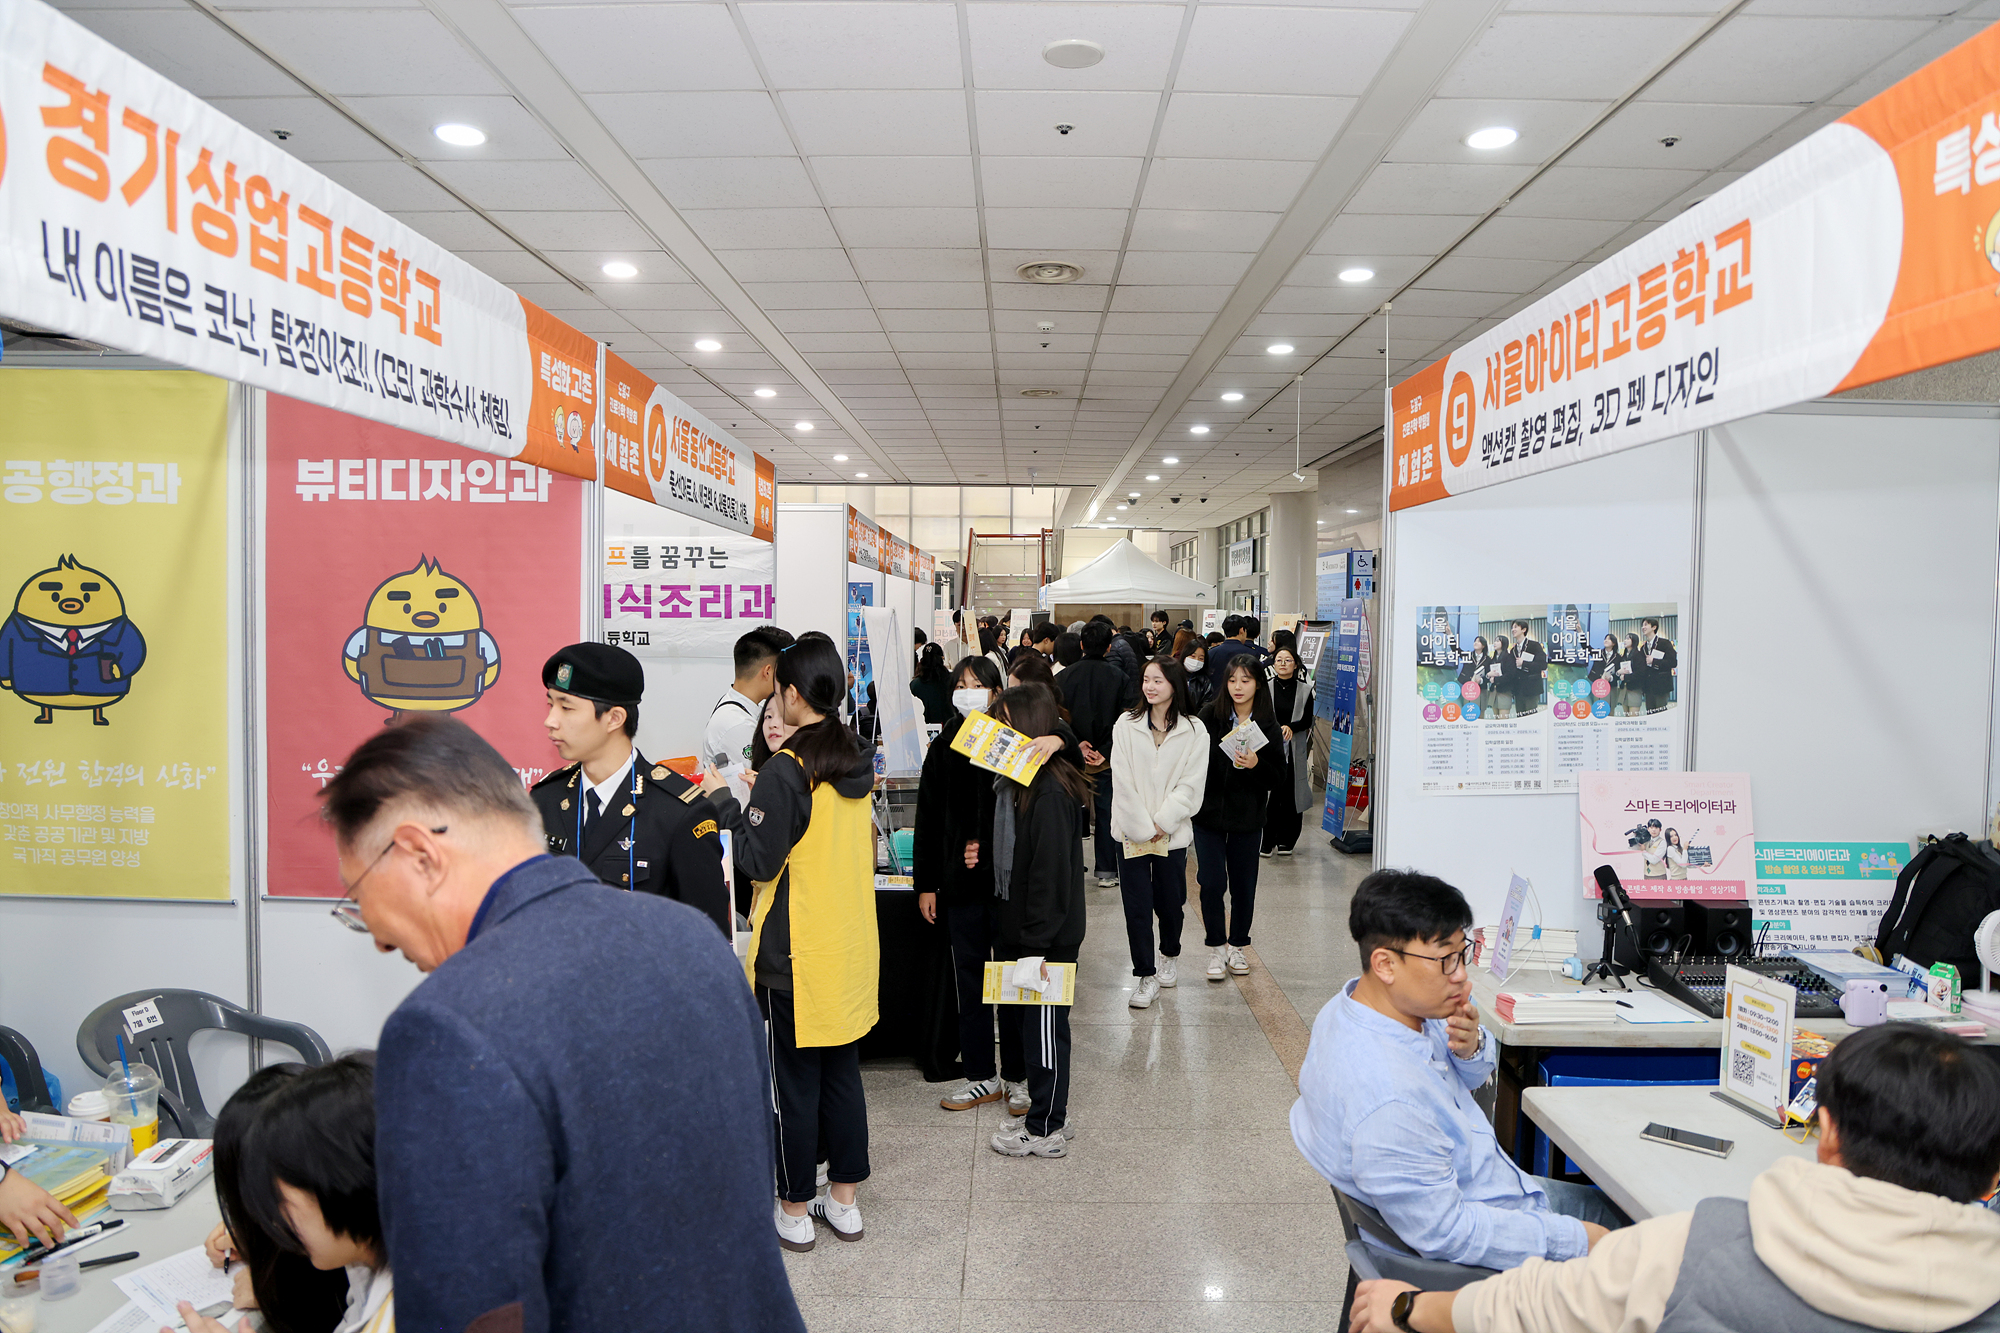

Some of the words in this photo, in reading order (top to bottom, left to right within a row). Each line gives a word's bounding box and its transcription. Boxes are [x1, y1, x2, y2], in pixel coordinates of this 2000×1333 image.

[39, 61, 443, 347] 경기상업고등학교
[41, 219, 86, 302] 내
[95, 241, 198, 337] 이름은
[204, 282, 267, 366] 코난,
[420, 367, 480, 430] 과학수사
[1482, 218, 1753, 411] 서울아이티고등학교
[1410, 395, 1422, 414] 도봉구
[1482, 422, 1516, 469] 액션캠
[1518, 411, 1547, 460] 촬영
[1550, 399, 1582, 446] 편집,
[1590, 387, 1620, 434] 3D
[1626, 375, 1646, 427] 펜
[1651, 347, 1719, 415] 디자인
[1418, 412, 1430, 430] 박람회
[1452, 392, 1468, 450] 9
[652, 424, 662, 468] 4
[670, 415, 736, 486] 서울동산고등학교
[1398, 444, 1433, 488] 체험존
[2, 458, 182, 506] 공행정과
[296, 458, 552, 503] 뷰티디자인과
[660, 546, 728, 570] 꿈꾸는
[1420, 617, 1447, 633] 서울
[1551, 615, 1578, 631] 서울
[1420, 634, 1459, 649] 아이티
[1551, 631, 1590, 647] 아이티
[1420, 650, 1473, 666] 고등학교
[1551, 648, 1603, 664] 고등학교
[970, 718, 986, 735] 먼저
[964, 734, 977, 749] 3년
[16, 759, 66, 787] 전원
[78, 760, 144, 788] 합격의
[43, 804, 106, 823] 사무행정
[110, 806, 155, 824] 능력을
[1624, 800, 1736, 814] 스마트크리에이터과
[4, 824, 31, 842] 갖춘
[34, 825, 97, 844] 공공기관
[101, 827, 115, 845] 및
[119, 828, 150, 846] 지방
[13, 847, 56, 865] 국가직
[60, 848, 106, 866] 공무원
[110, 850, 140, 868] 양성
[1755, 849, 1850, 862] 스마트크리에이터과
[1764, 865, 1781, 875] 방송
[1783, 865, 1800, 875] 촬영
[1802, 866, 1808, 874] &
[1810, 865, 1826, 875] 영상
[1828, 865, 1845, 875] 편집
[1651, 885, 1664, 893] 제작
[1675, 885, 1703, 894] 방송촬영
[1710, 885, 1737, 895] 영상기획
